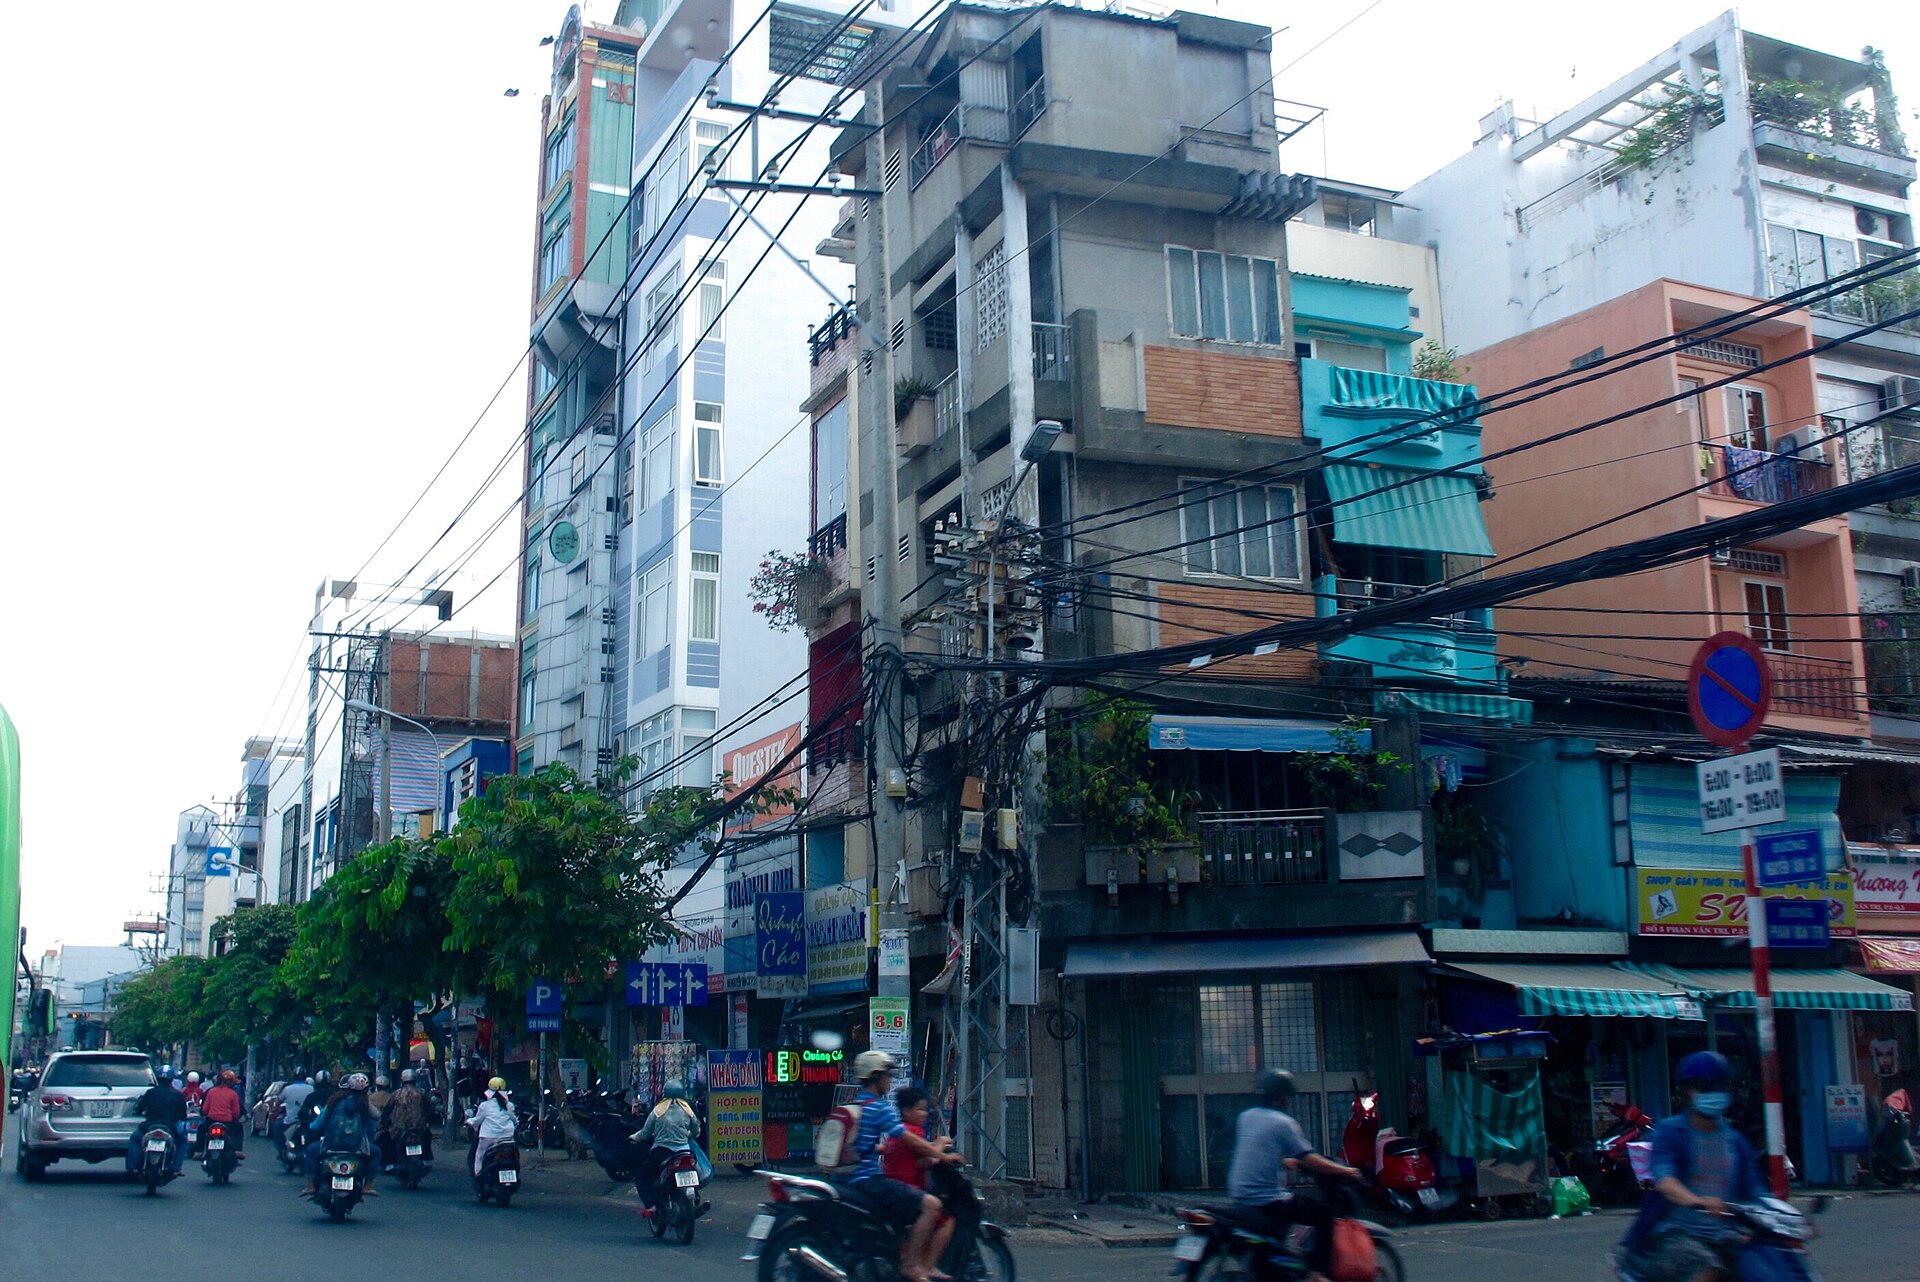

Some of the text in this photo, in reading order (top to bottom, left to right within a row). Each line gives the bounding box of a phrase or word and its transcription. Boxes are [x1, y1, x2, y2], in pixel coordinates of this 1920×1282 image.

[1705, 770, 1730, 792] 6:00
[1646, 875, 1672, 886] SHOP
[760, 899, 803, 943] Quảng
[762, 938, 801, 969] Cáo
[536, 986, 551, 1006] P
[803, 1049, 831, 1063] Quảng
[711, 1052, 759, 1087] KHẮC DẤU
[767, 1051, 801, 1084] LED
[742, 1139, 760, 1149] LED
